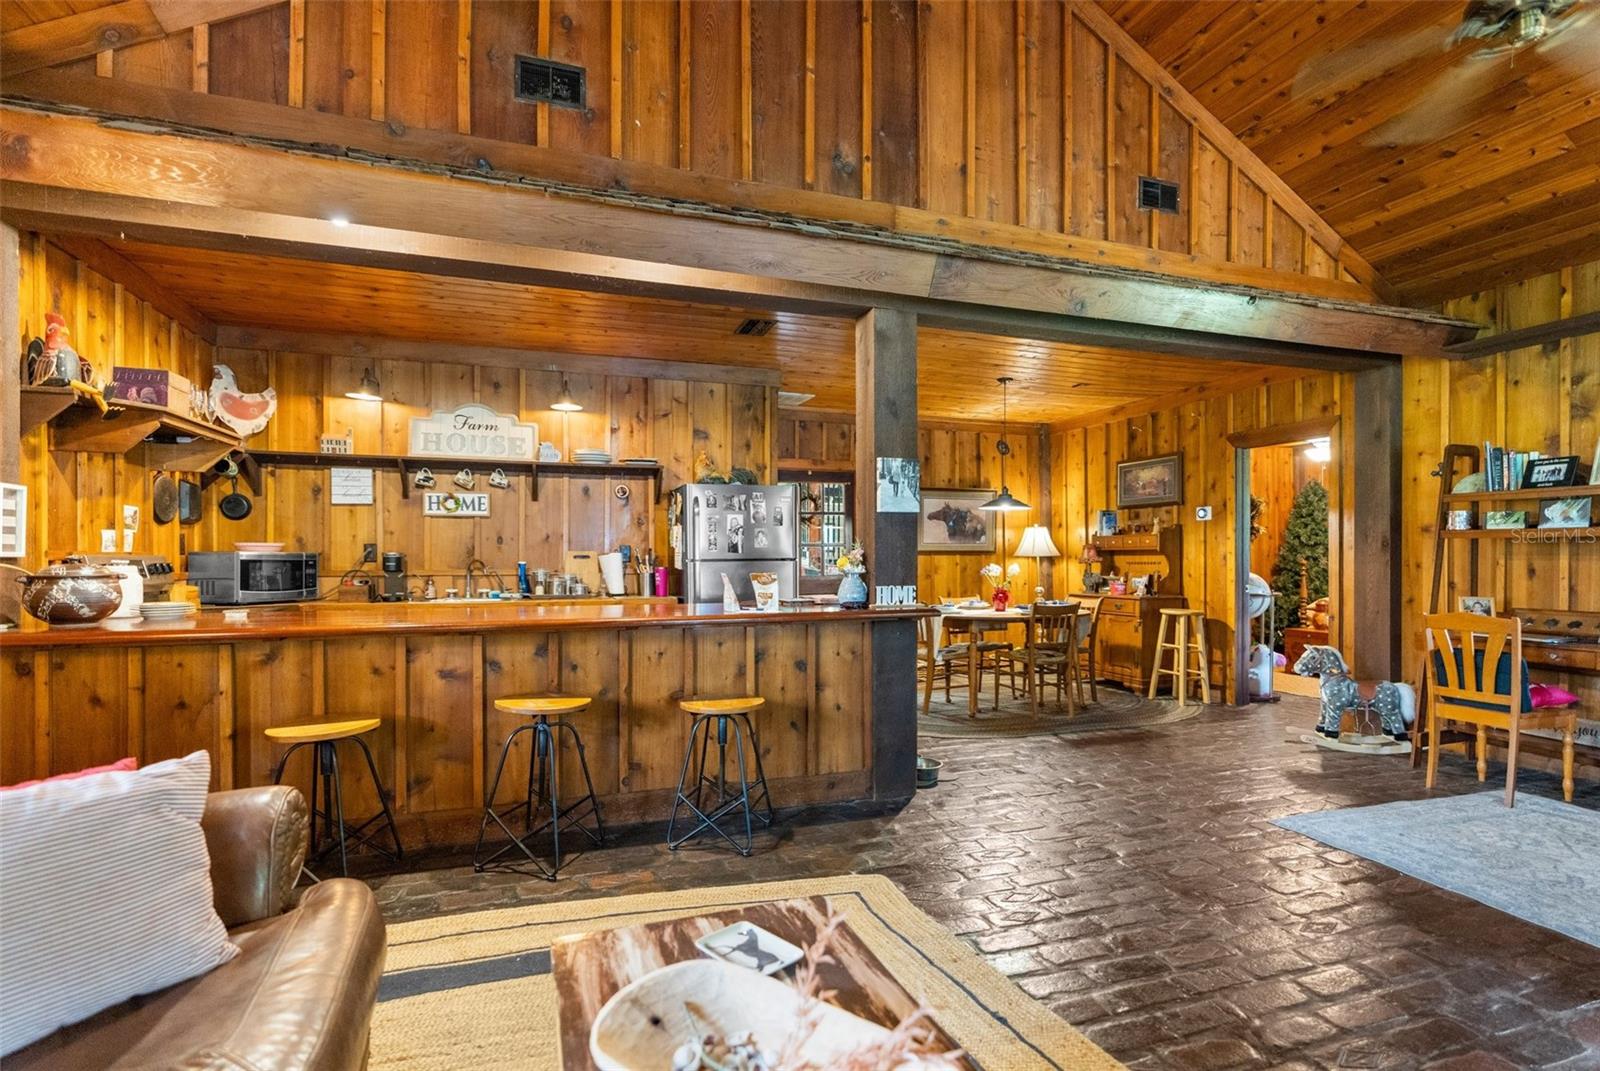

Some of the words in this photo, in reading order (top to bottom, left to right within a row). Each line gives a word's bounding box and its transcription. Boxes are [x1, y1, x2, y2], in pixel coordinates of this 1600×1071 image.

[452, 414, 500, 431] Farm
[420, 432, 527, 456] HOUSE
[427, 494, 488, 513] HOME
[876, 585, 916, 606] HOME
